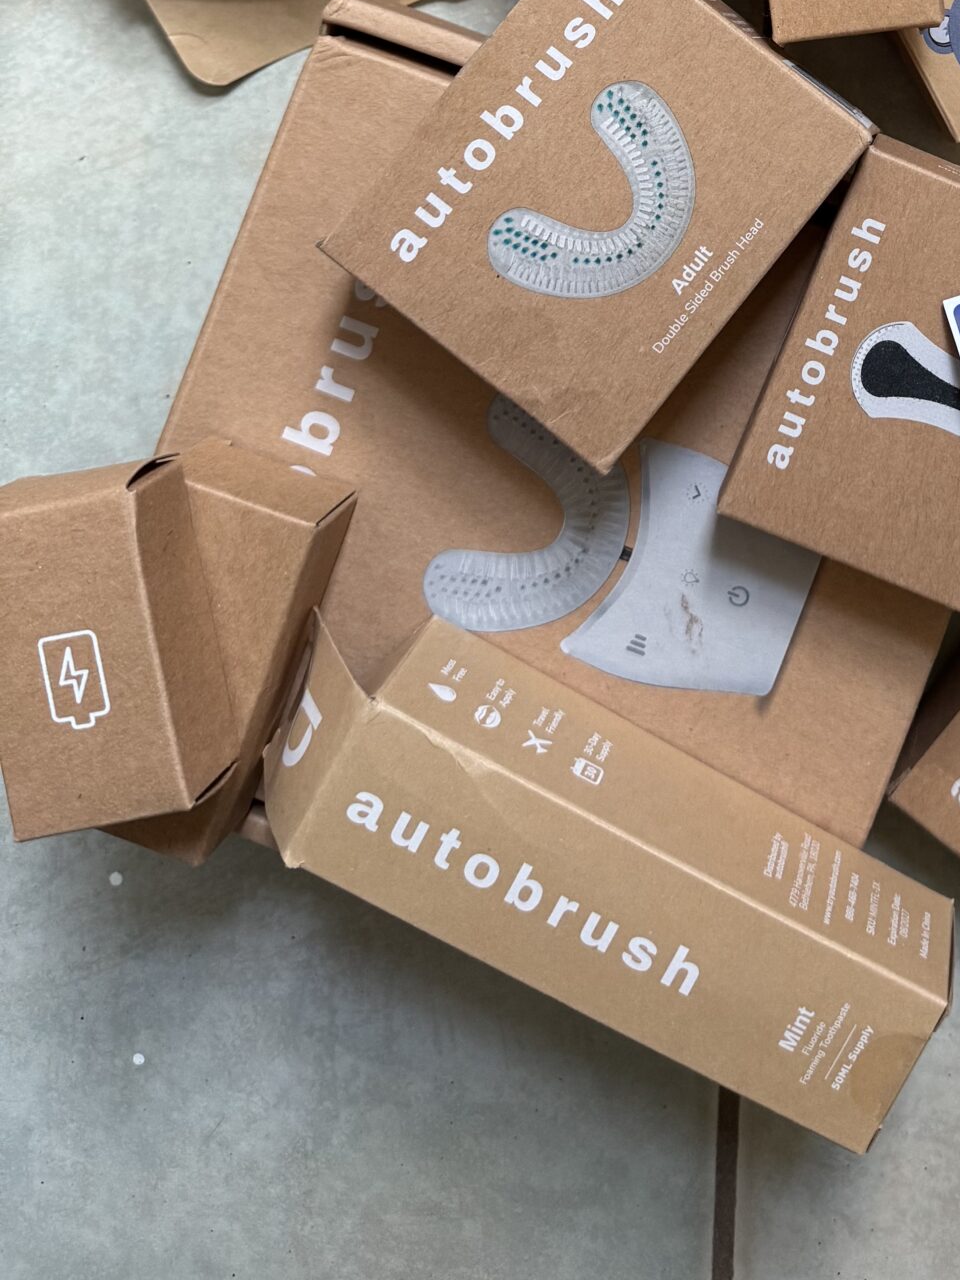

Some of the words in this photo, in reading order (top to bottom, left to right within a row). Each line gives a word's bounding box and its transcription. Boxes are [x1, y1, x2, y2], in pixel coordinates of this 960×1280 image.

[651, 312, 690, 355] Double
[683, 280, 715, 315] Sided
[708, 246, 741, 282] Brush
[734, 217, 766, 252] Head
[671, 244, 715, 296] Adult
[765, 216, 887, 471] autobrush
[584, 765, 599, 780] 30
[345, 790, 702, 997] autobrush
[778, 1005, 816, 1053] Mint
[798, 1049, 827, 1086] Foaming
[819, 1002, 852, 1050] Toothpaste
[801, 1020, 827, 1056] Fluoride
[830, 1062, 854, 1091] 50ML
[847, 1024, 875, 1063] Supply
